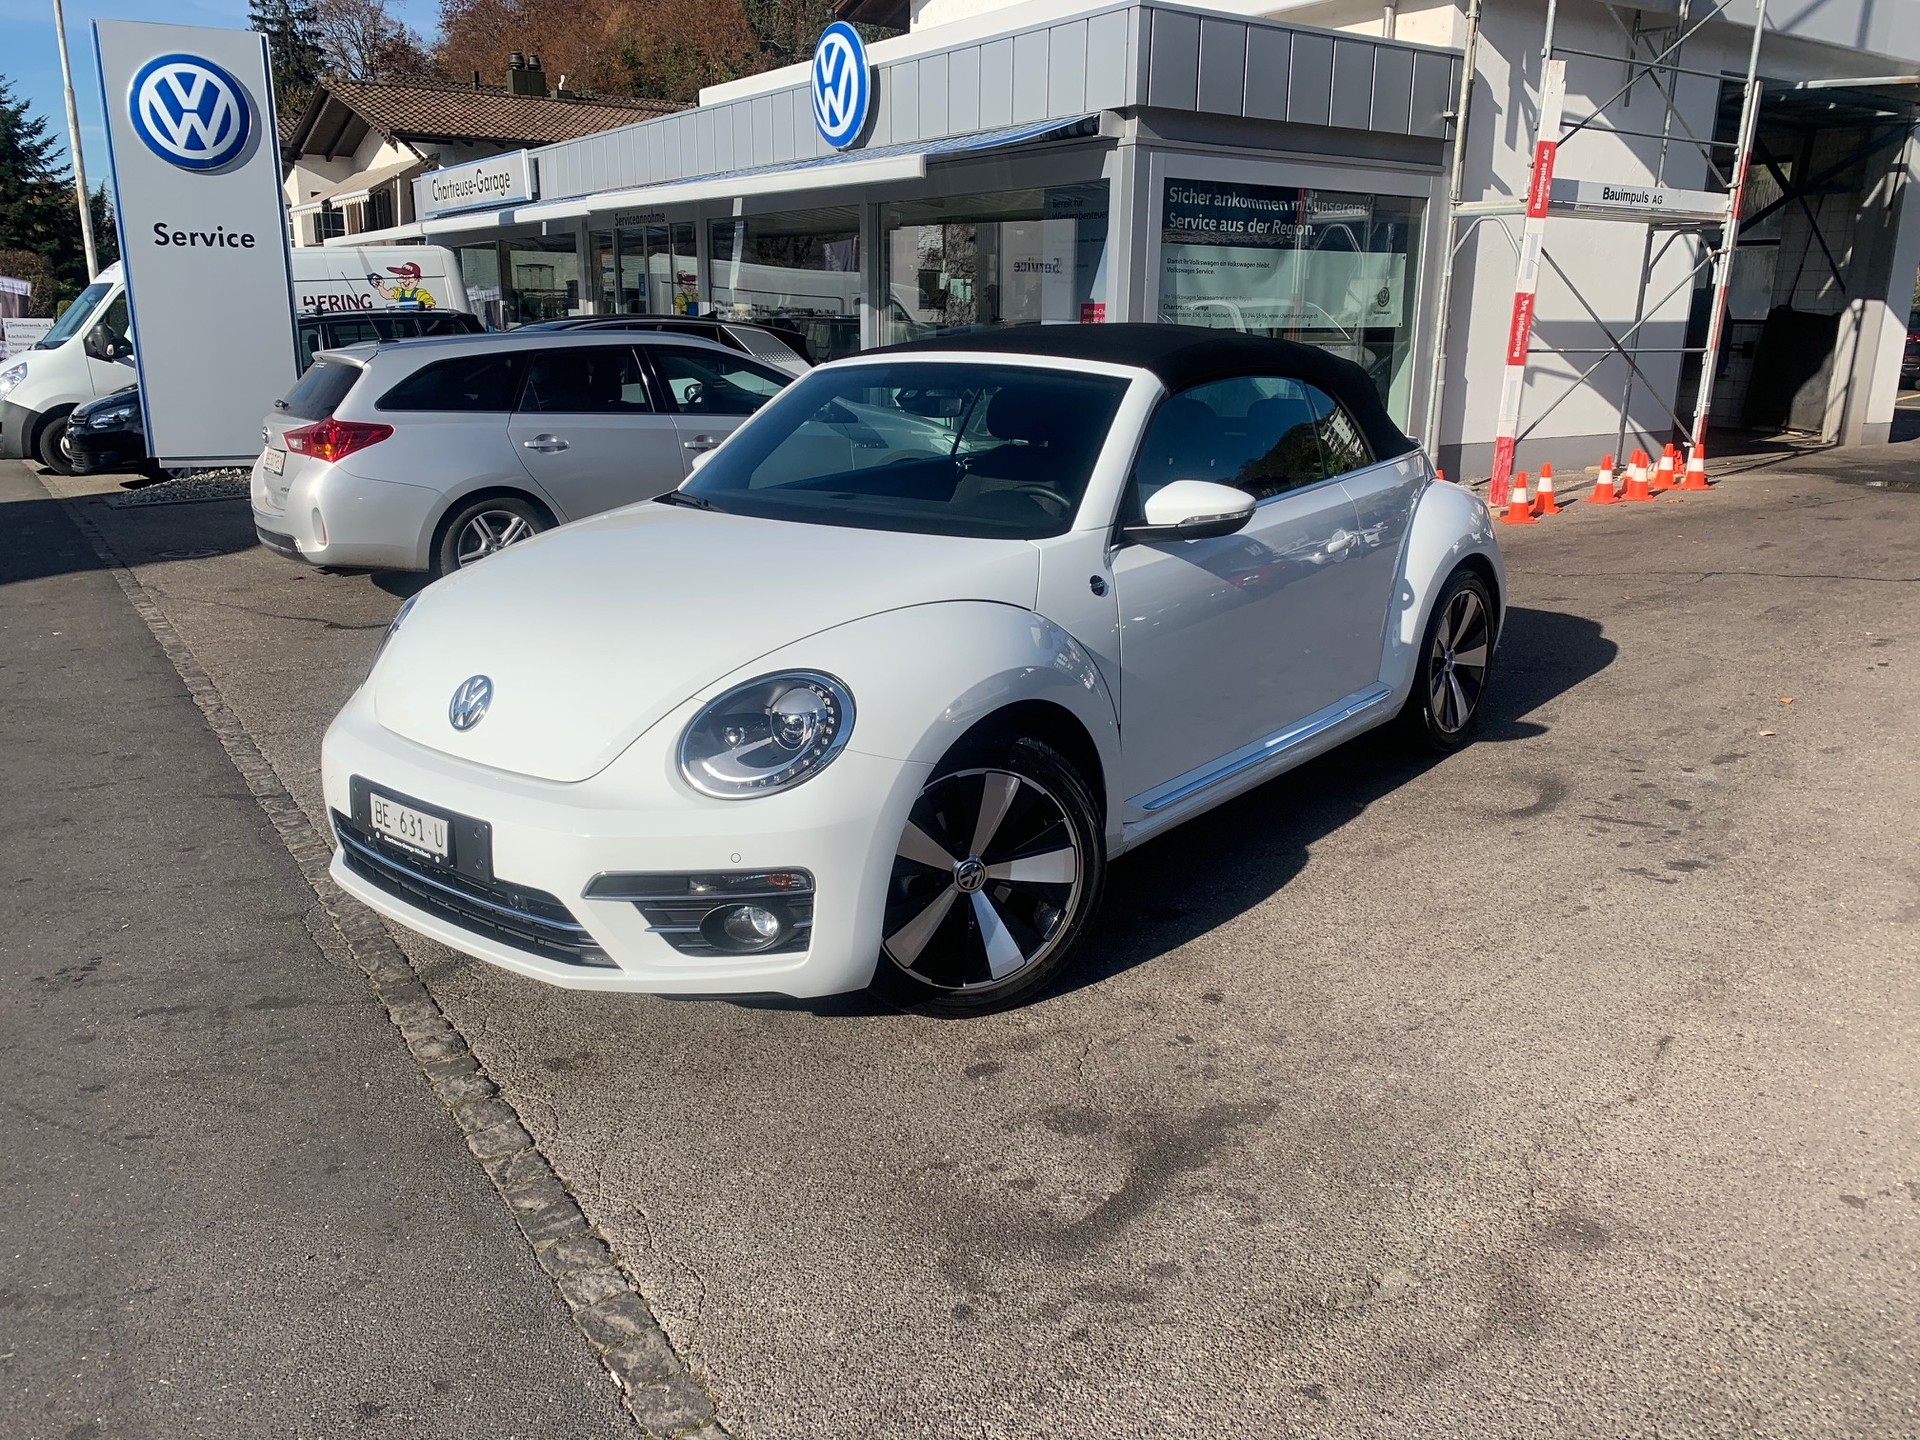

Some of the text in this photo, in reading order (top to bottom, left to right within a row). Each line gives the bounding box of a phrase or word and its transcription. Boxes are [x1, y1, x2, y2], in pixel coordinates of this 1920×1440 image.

[134, 58, 247, 164] VW
[432, 168, 510, 202] Chartreuse-Garage
[1534, 148, 1550, 210] Bauimpuls AG
[1169, 186, 1212, 205] Sicher
[1214, 192, 1289, 212] ankommen
[1603, 187, 1663, 205] Bauimpuls AG
[614, 208, 666, 226] Serviceannahme
[1169, 212, 1316, 238] Service aus der Region.
[153, 222, 255, 249] Service
[303, 294, 373, 312] HERING
[1513, 312, 1526, 358] Bauimpuls
